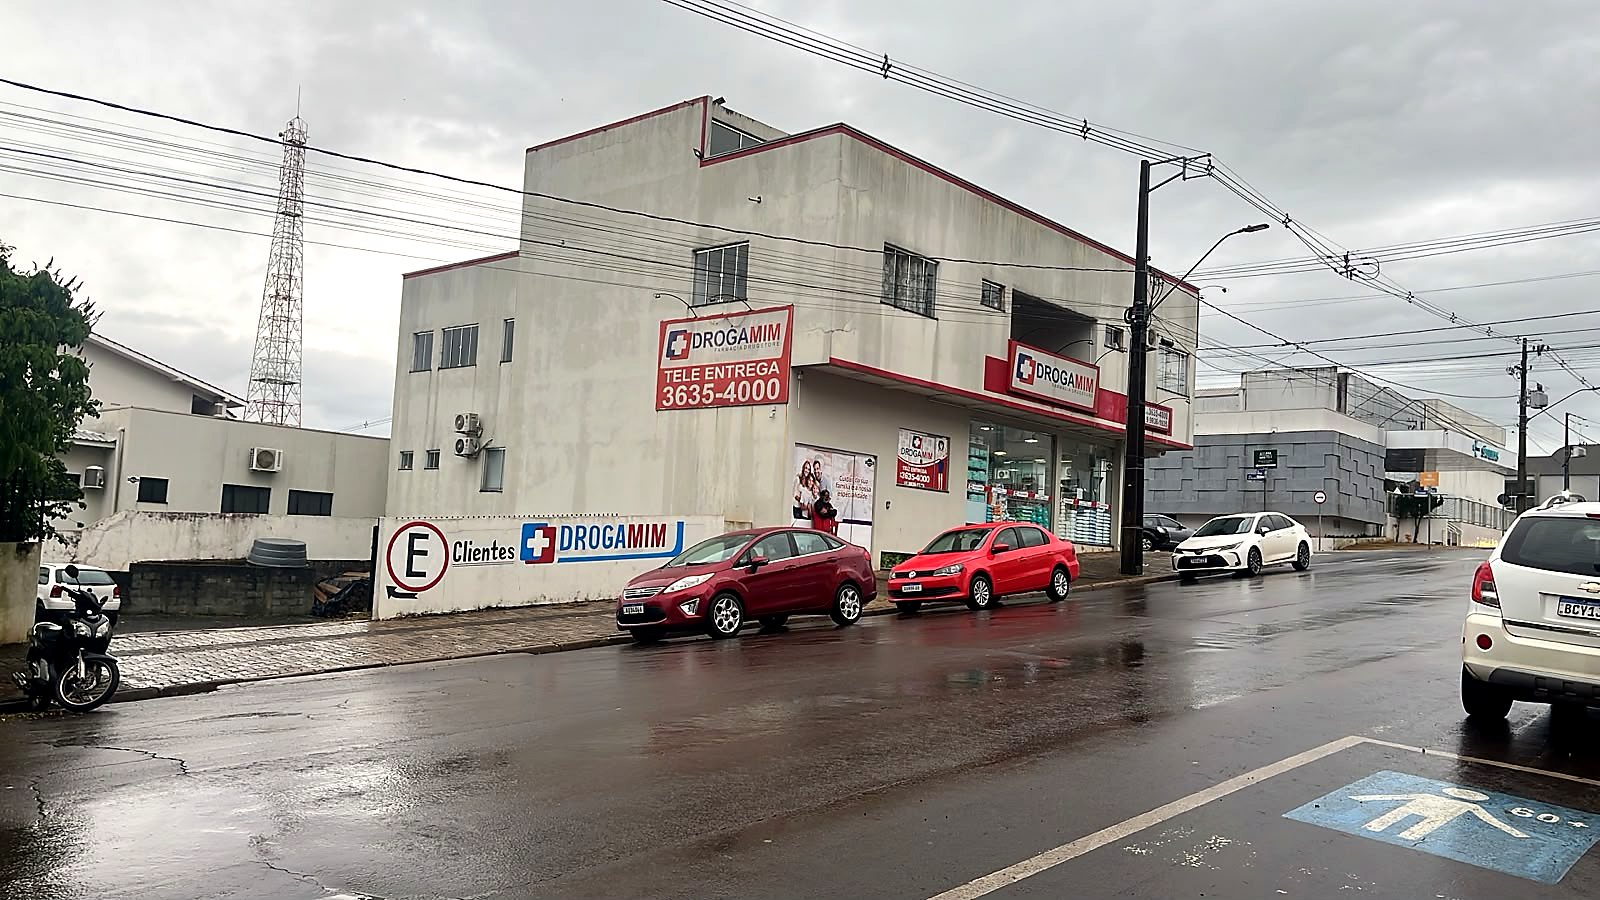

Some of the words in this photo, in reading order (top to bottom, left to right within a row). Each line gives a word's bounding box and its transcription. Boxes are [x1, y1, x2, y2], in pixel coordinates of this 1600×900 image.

[692, 323, 781, 349] DROGAMIM
[664, 368, 700, 383] TELE
[705, 362, 780, 380] ENTREGA
[1036, 362, 1094, 393] DROGAMIM
[662, 378, 780, 407] 3635-4000
[901, 447, 932, 459] DROGAMIM
[560, 524, 666, 551] DROGAMIM
[406, 532, 430, 578] E
[452, 540, 515, 562] Clientes
